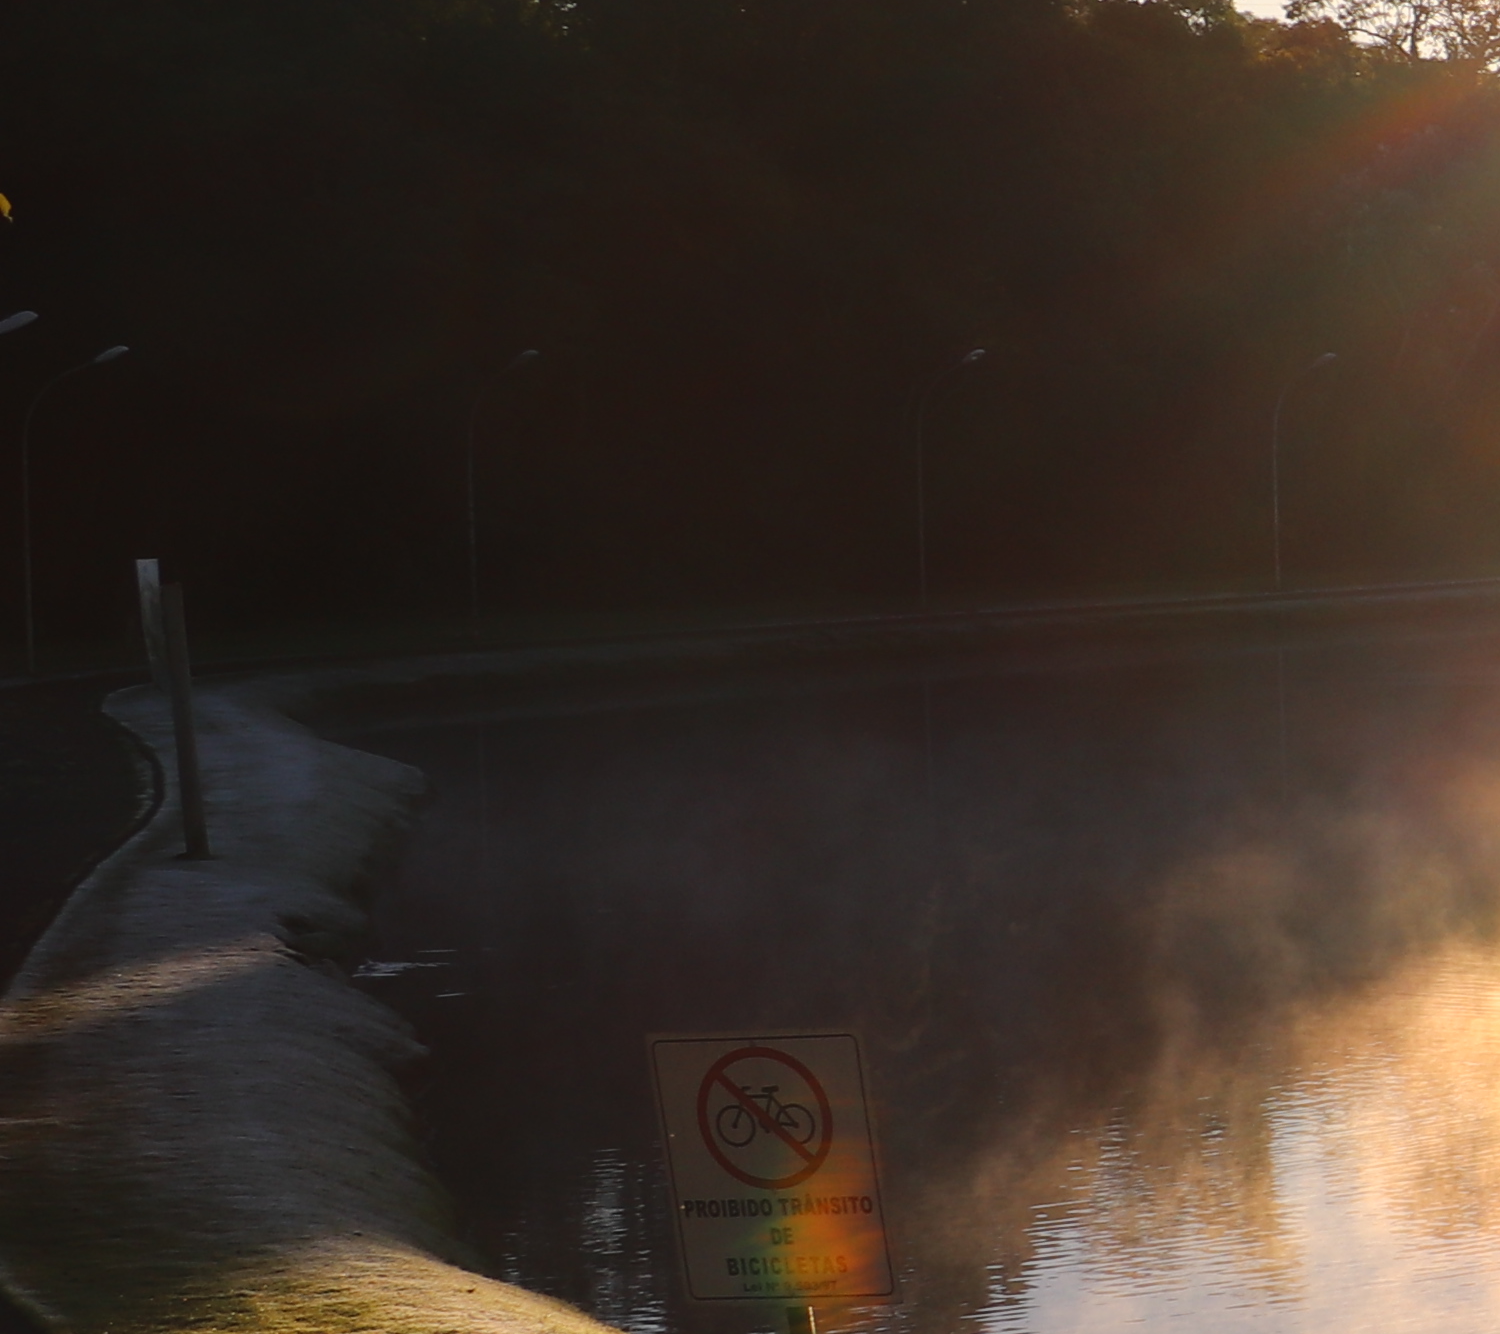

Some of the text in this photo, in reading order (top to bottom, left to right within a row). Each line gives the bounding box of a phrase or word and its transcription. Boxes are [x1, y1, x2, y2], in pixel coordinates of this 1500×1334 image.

[683, 1192, 874, 1219] PROIBIDO TRÂNSITO
[769, 1226, 796, 1245] DE
[724, 1254, 849, 1277] BICICLETAS
